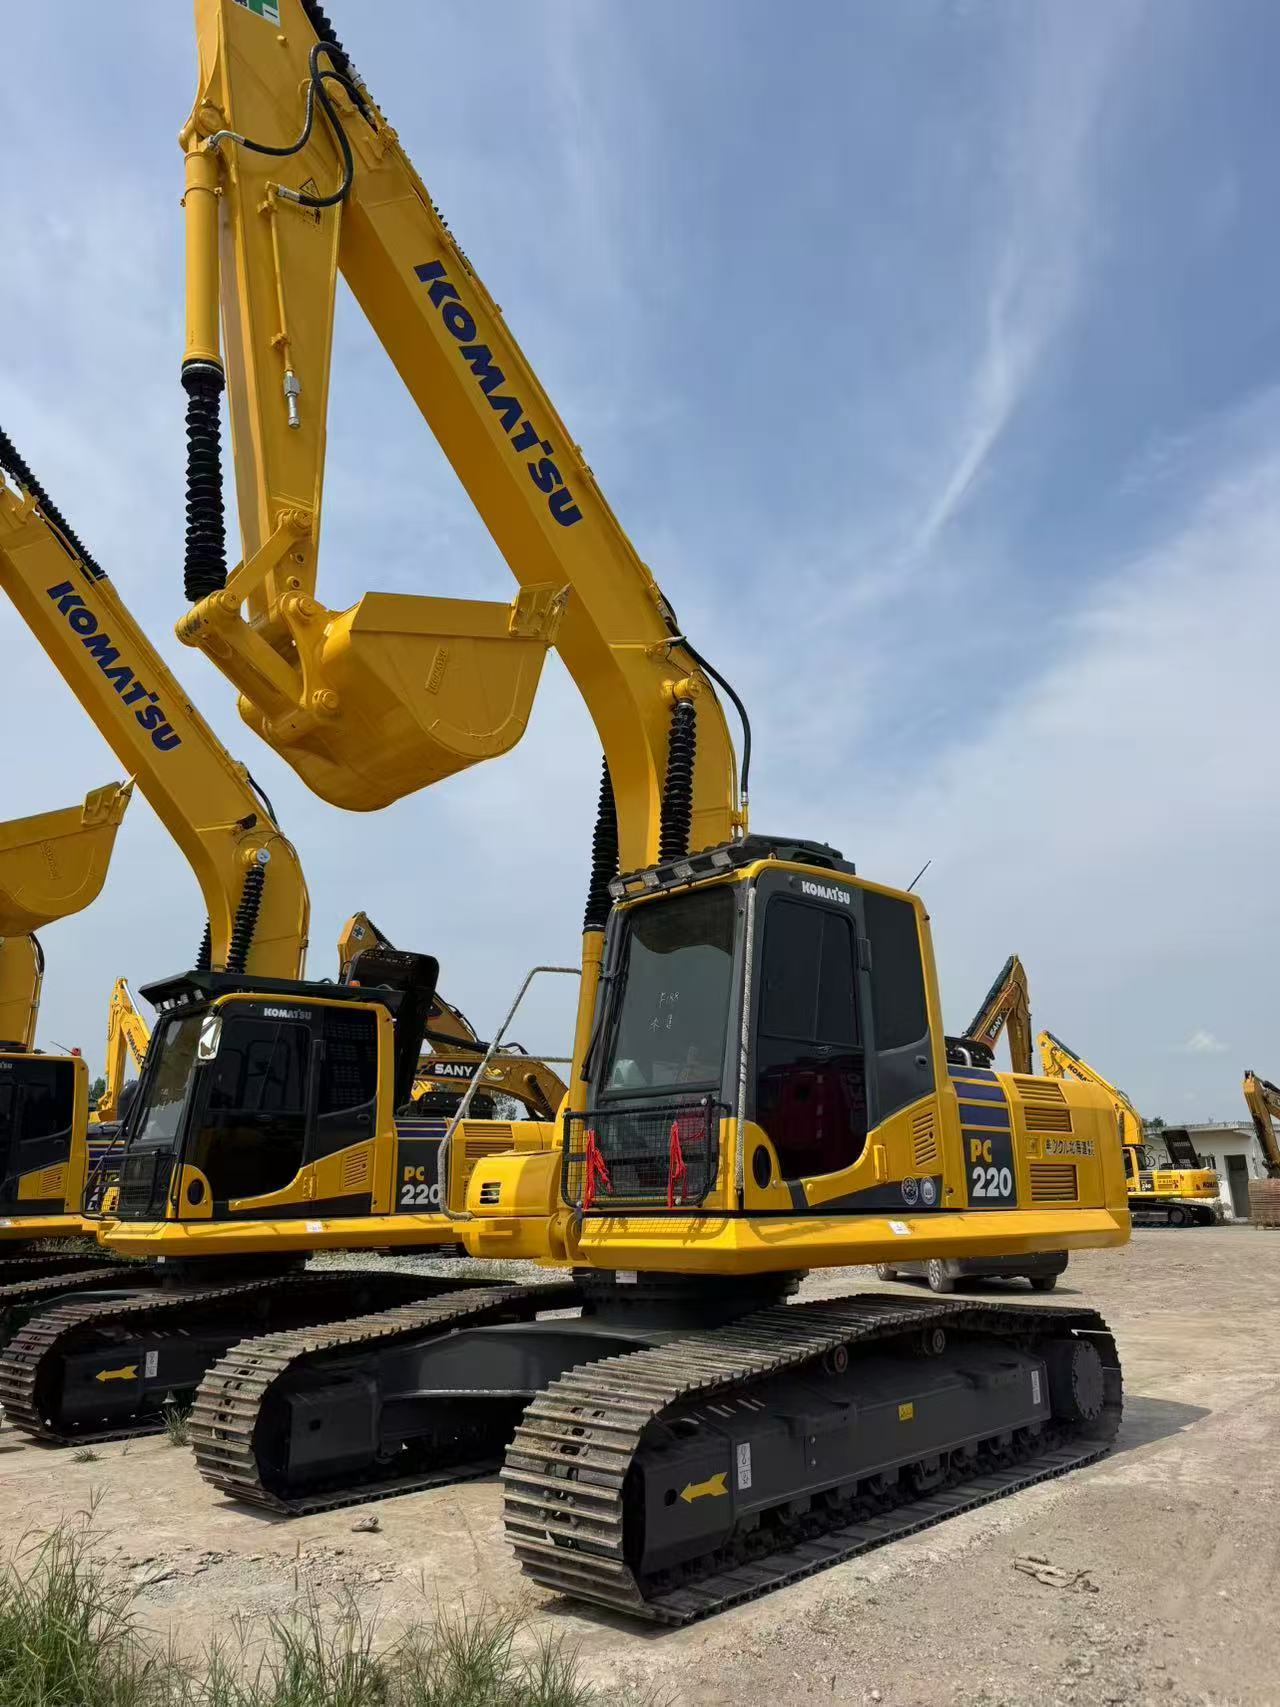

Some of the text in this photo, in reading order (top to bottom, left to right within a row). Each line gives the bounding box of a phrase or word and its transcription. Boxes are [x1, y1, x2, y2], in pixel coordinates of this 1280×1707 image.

[413, 260, 583, 527] KOMATSU
[46, 580, 182, 751] KOMATSU
[801, 880, 850, 905] KOMATSU
[264, 1007, 312, 1020] KOMATSU
[434, 1063, 473, 1077] SANY
[970, 1138, 993, 1163] PC
[404, 1165, 425, 1181] PC
[972, 1166, 1013, 1197] 220
[400, 1184, 440, 1205] 220
